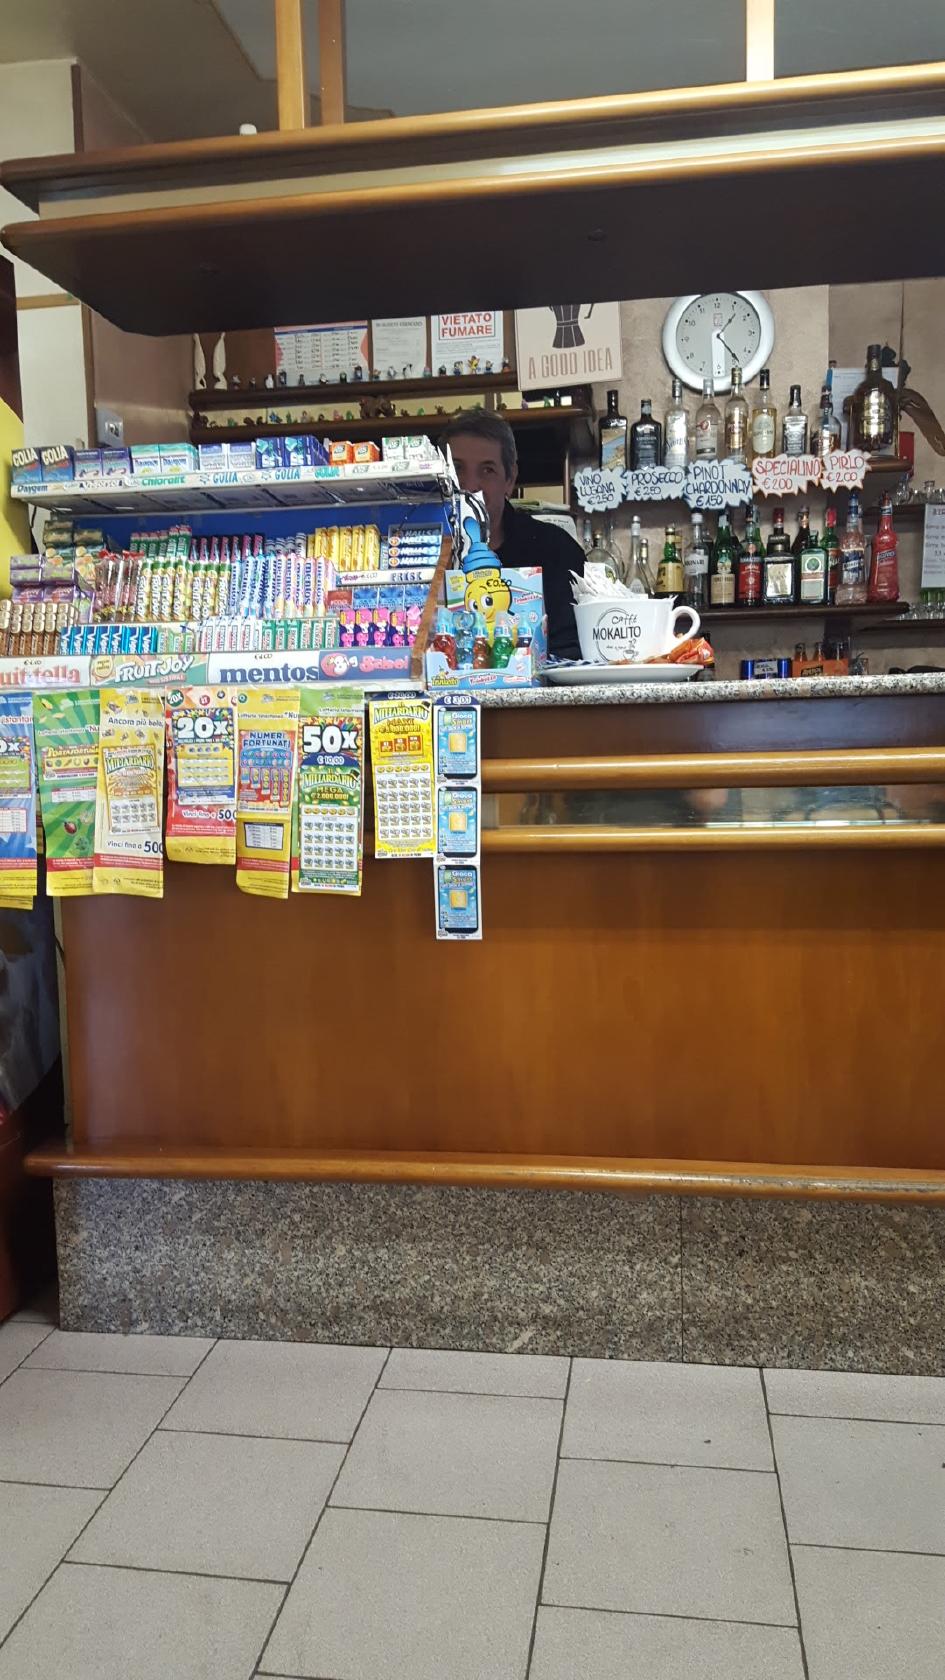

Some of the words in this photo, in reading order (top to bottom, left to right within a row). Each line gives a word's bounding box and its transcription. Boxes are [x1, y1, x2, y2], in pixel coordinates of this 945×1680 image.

[441, 313, 492, 327] VIETATO
[441, 324, 493, 338] FUMARE
[528, 356, 537, 380] A
[541, 352, 577, 378] GOOD
[583, 347, 613, 373] IDEA
[756, 459, 820, 476] SPECIALINO
[830, 455, 864, 470] PIRLO
[580, 473, 601, 486] VINO
[632, 471, 683, 486] PROSECCO
[693, 464, 728, 480] PINOT
[686, 479, 751, 495] CHARDONNAY
[592, 626, 641, 640] MOKALITO
[219, 663, 319, 683] mentos
[243, 739, 291, 748] FORTUNATI
[303, 725, 358, 753] 50x
